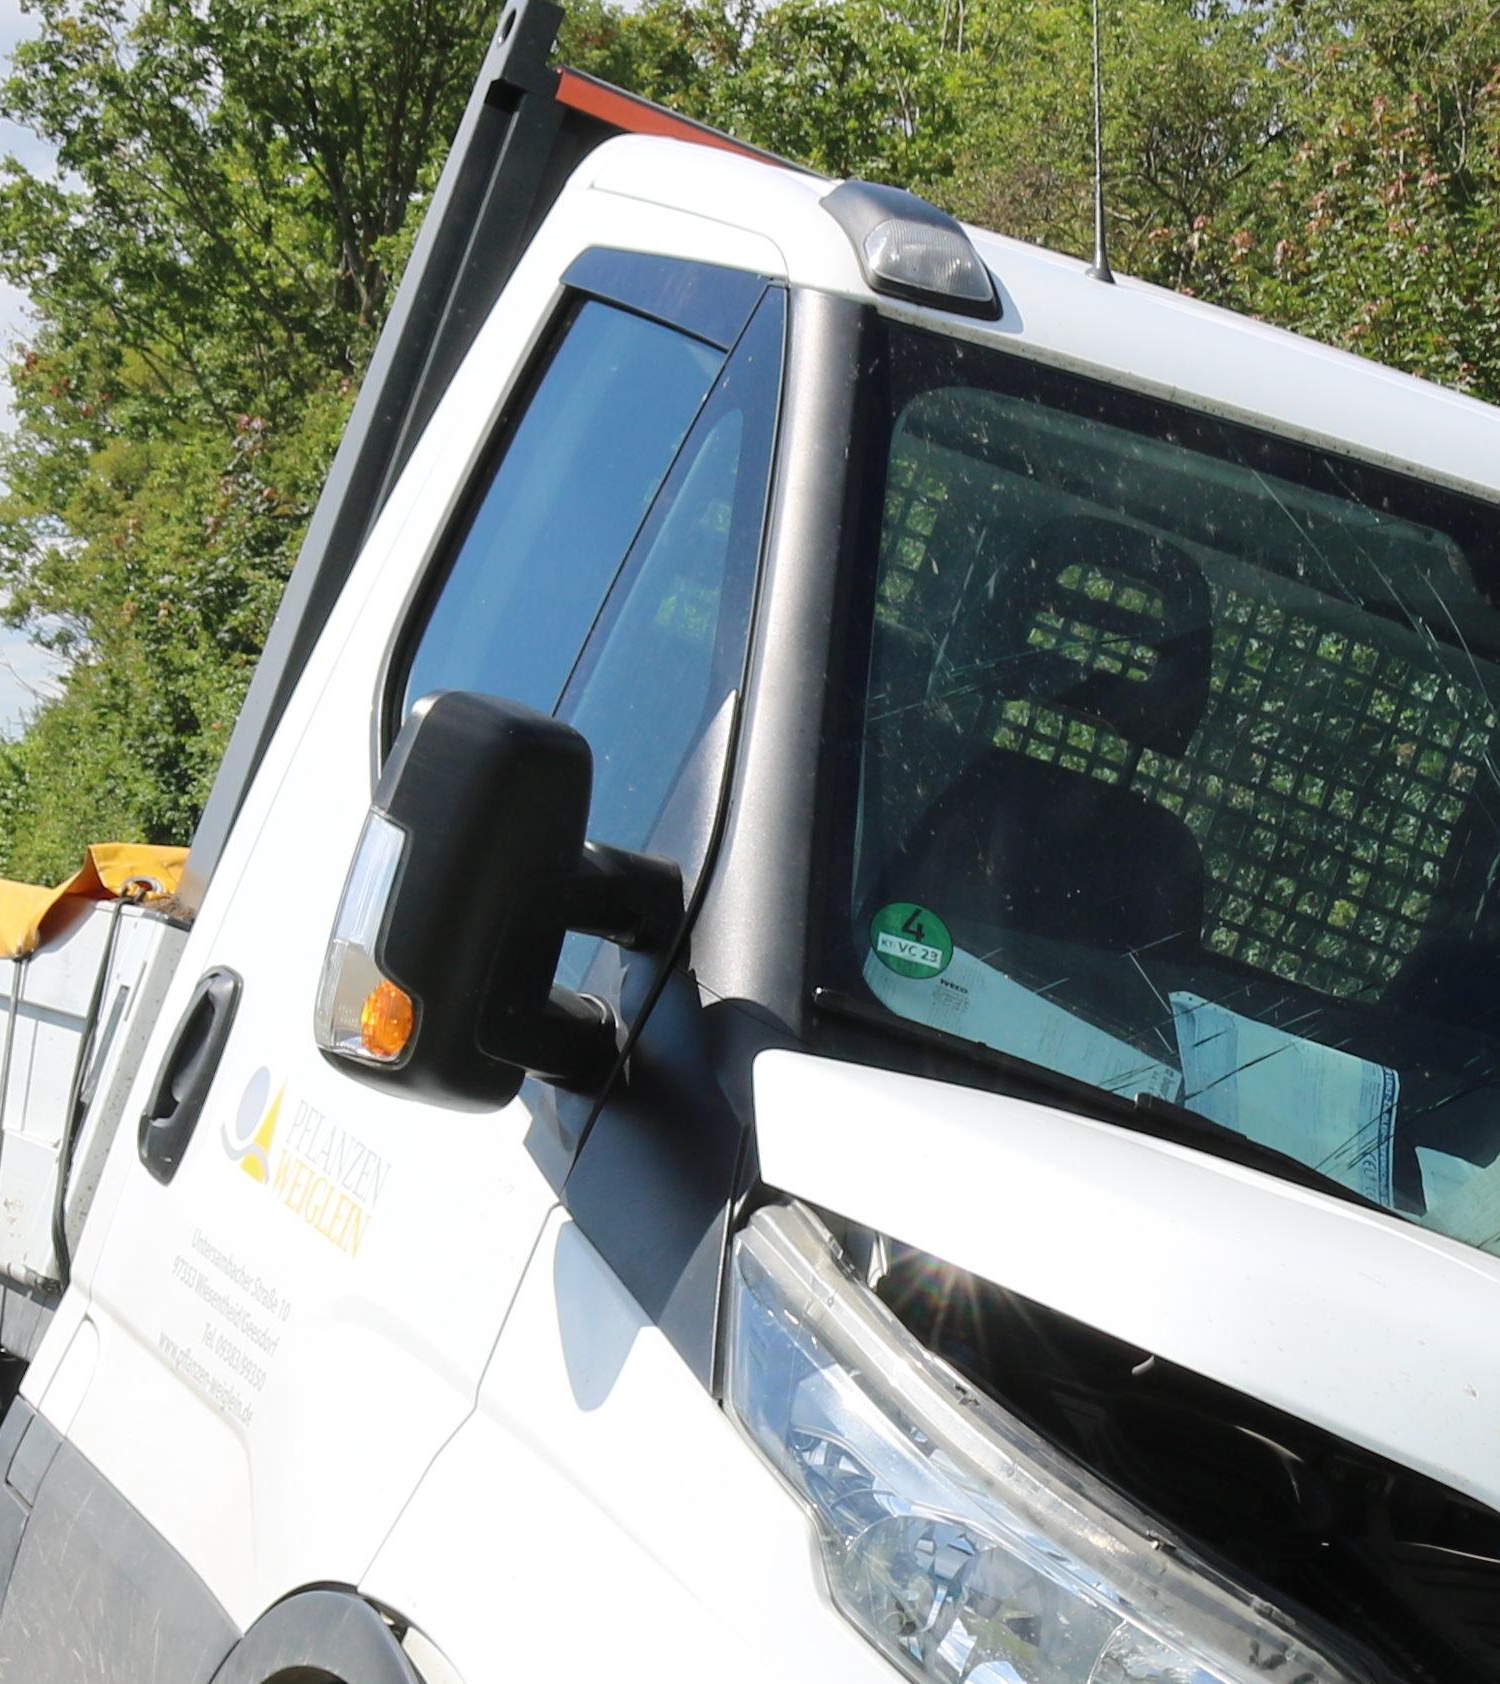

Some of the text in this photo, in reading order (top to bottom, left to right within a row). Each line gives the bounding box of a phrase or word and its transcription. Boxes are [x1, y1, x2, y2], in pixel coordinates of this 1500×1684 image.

[901, 908, 925, 942] 4
[898, 941, 917, 957] VC
[920, 948, 938, 963] 23
[939, 978, 969, 994] IVECO
[285, 1098, 393, 1210] PFLANZEN
[271, 1147, 373, 1260] WEIGLEIN
[171, 1254, 198, 1289] 97353
[250, 1275, 280, 1315] Straße
[277, 1298, 291, 1323] 10
